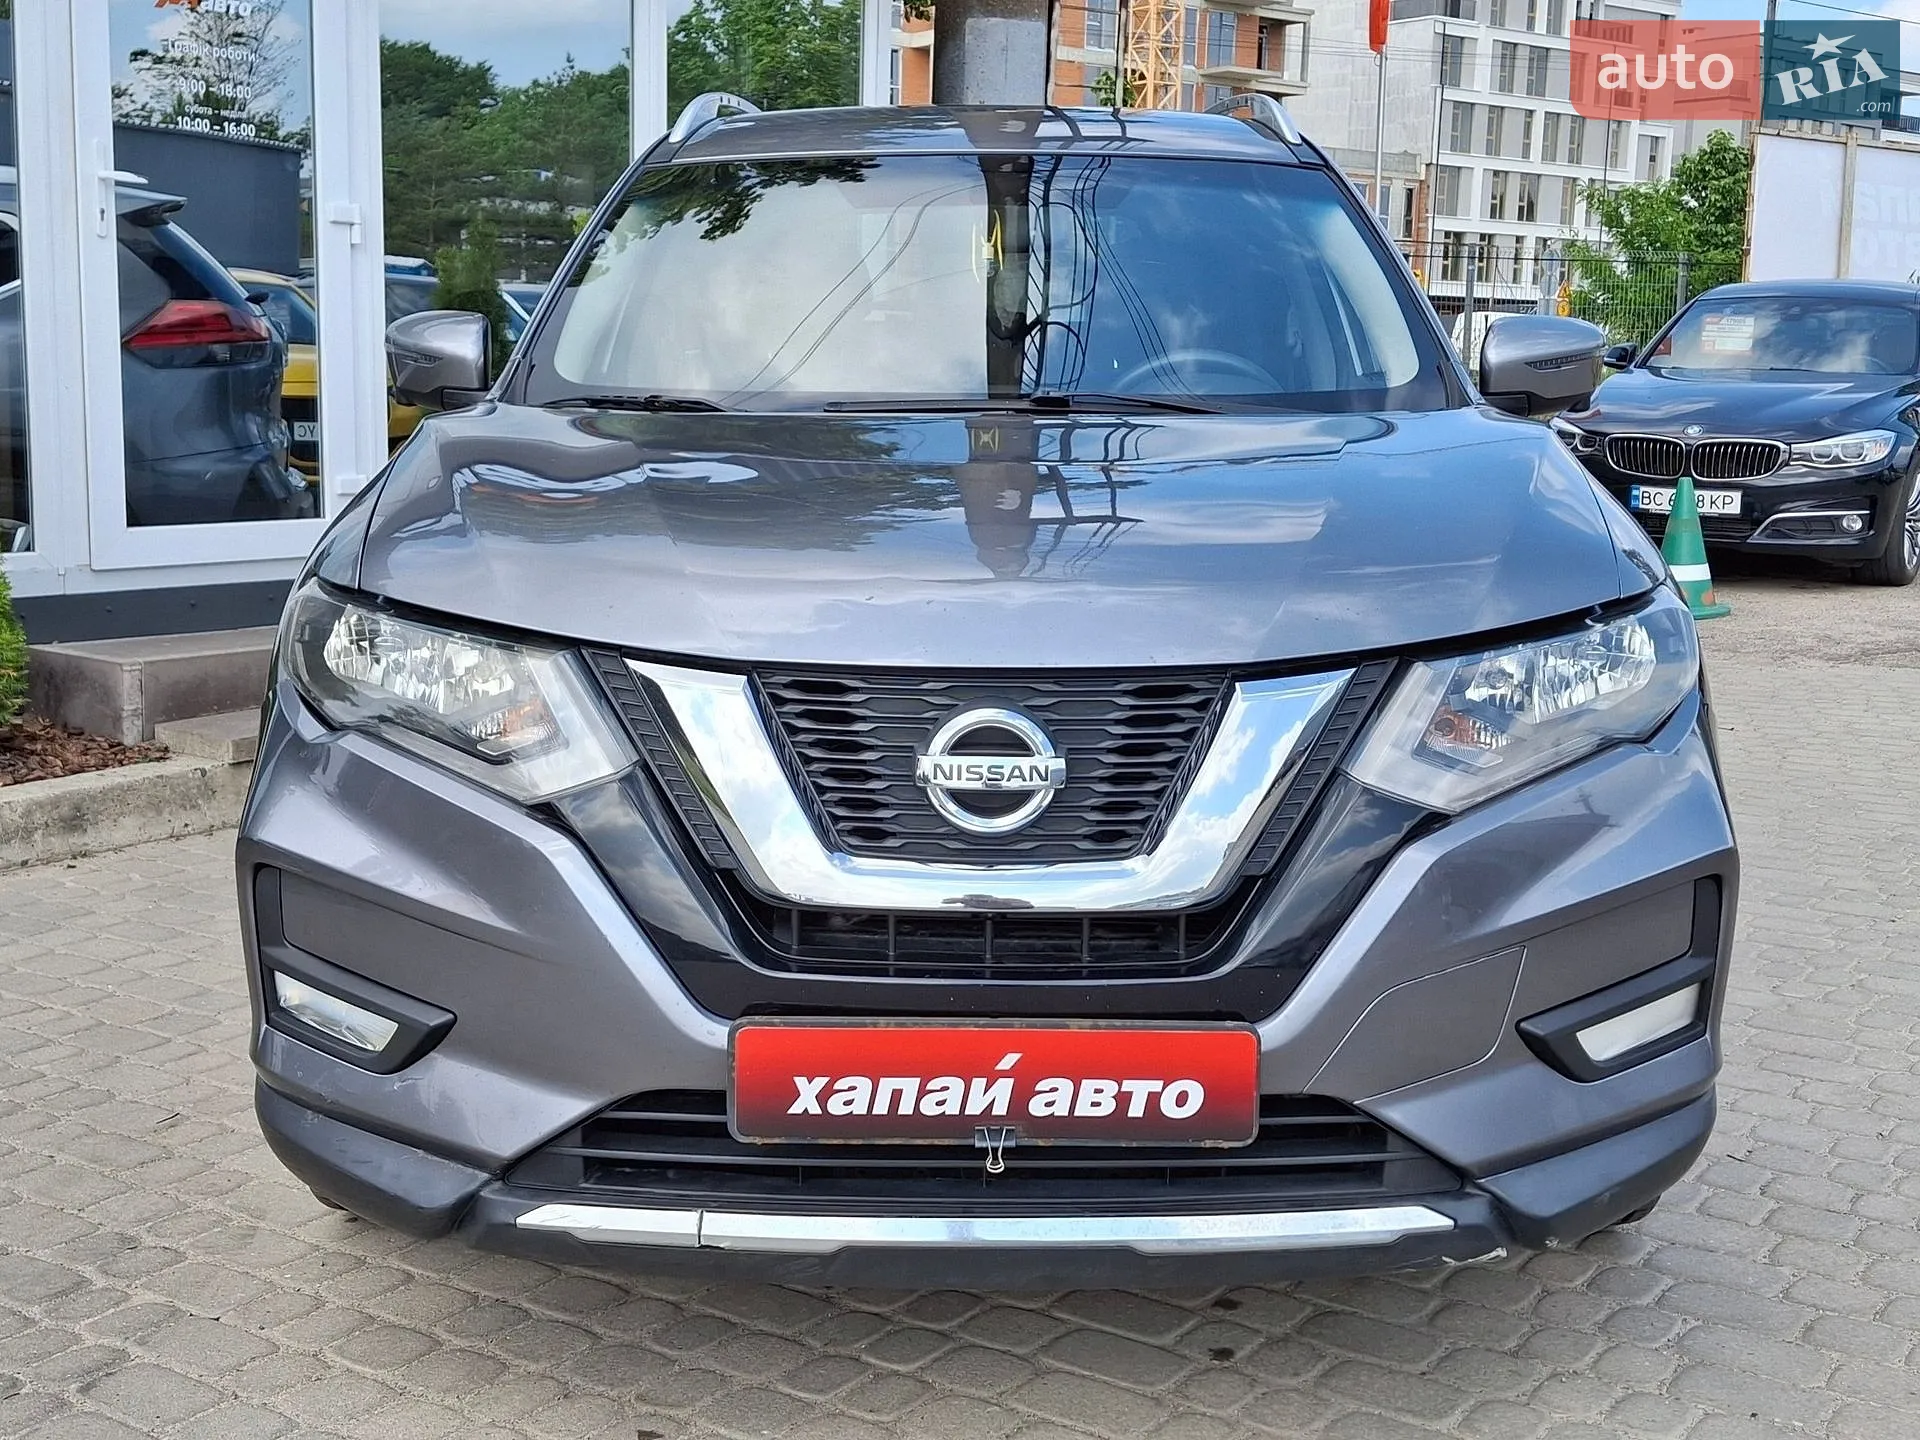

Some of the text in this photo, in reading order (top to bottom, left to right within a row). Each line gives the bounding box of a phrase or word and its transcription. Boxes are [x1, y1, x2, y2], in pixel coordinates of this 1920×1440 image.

[179, 78, 206, 94] 9:00
[220, 83, 251, 98] 18:00
[184, 104, 213, 117] субота
[177, 115, 210, 132] 10:00
[223, 121, 256, 137] 16:00
[1641, 491, 1734, 510] BC 68 KP
[933, 763, 1049, 783] NISSAN
[787, 1052, 1205, 1120] хапай авто
